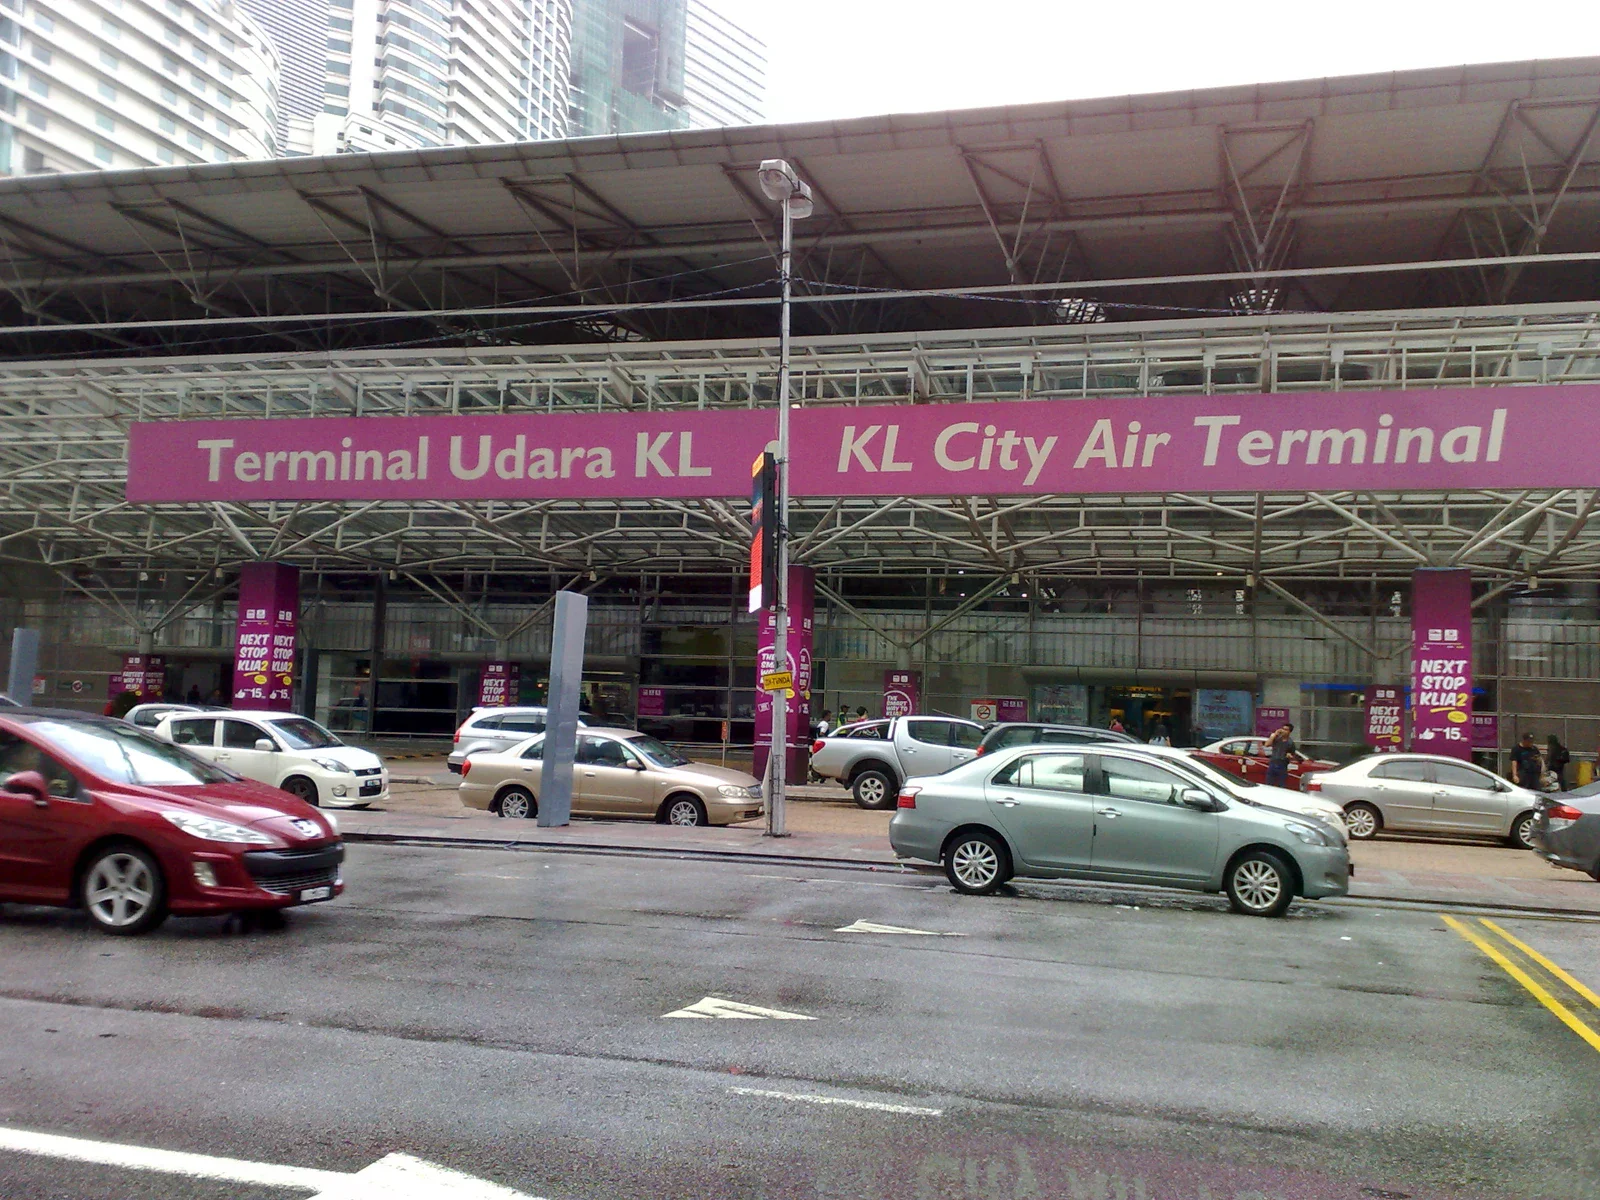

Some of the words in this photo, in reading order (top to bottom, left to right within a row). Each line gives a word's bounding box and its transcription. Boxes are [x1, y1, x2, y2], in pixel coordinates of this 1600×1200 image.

[837, 425, 913, 473] KL
[934, 422, 1059, 486] City
[1073, 419, 1172, 469] Air
[1193, 409, 1508, 467] Terminal
[197, 436, 429, 482] Terminal
[450, 432, 616, 480] Udara
[635, 431, 712, 479] KL
[240, 634, 270, 645] NEXT
[273, 635, 294, 647] NEXT
[240, 647, 268, 658] STOP
[273, 647, 292, 660] STOP
[238, 660, 269, 671] KLIA2
[1420, 660, 1467, 673] NEXT
[1421, 676, 1466, 690] STOP
[1420, 692, 1468, 706] KLIA2
[1370, 706, 1400, 715] NEXT
[1371, 716, 1399, 724] STOP
[1369, 725, 1400, 734] KLIA2
[1443, 727, 1460, 740] 15
